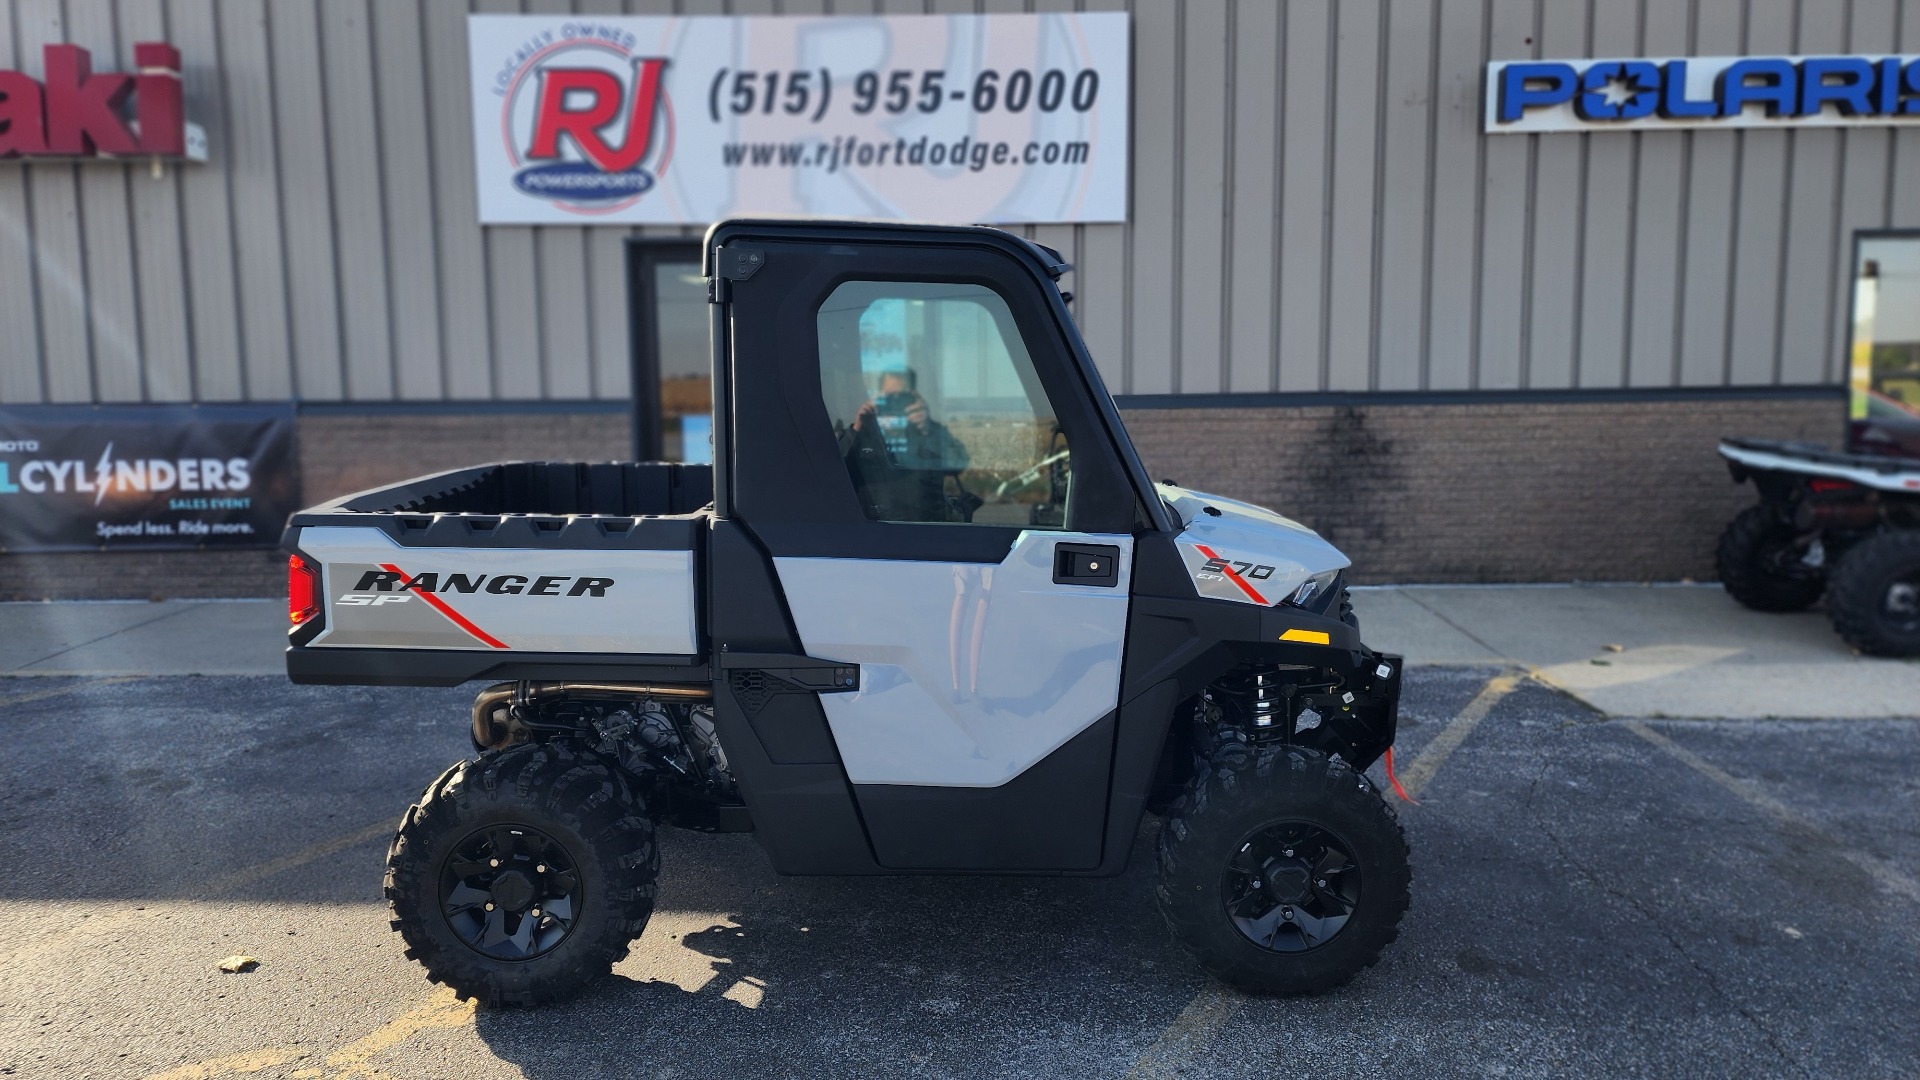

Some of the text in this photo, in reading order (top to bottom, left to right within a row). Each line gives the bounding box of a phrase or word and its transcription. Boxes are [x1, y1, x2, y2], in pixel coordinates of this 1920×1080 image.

[492, 22, 637, 97] LOCALLY OWNED
[708, 68, 1100, 123] (515) 955-6000
[1499, 57, 1920, 122] POLARI
[526, 57, 672, 174] RJ
[722, 136, 1091, 173] www.rjfortdodge.com
[525, 171, 648, 192] POWERSPORTS
[169, 498, 250, 510] SALES EVENT
[97, 520, 254, 538] Spend less. Ride more.
[1196, 573, 1224, 581] EFI
[1201, 557, 1276, 580] 570
[354, 571, 615, 598] RANGER
[335, 594, 412, 606] SP
